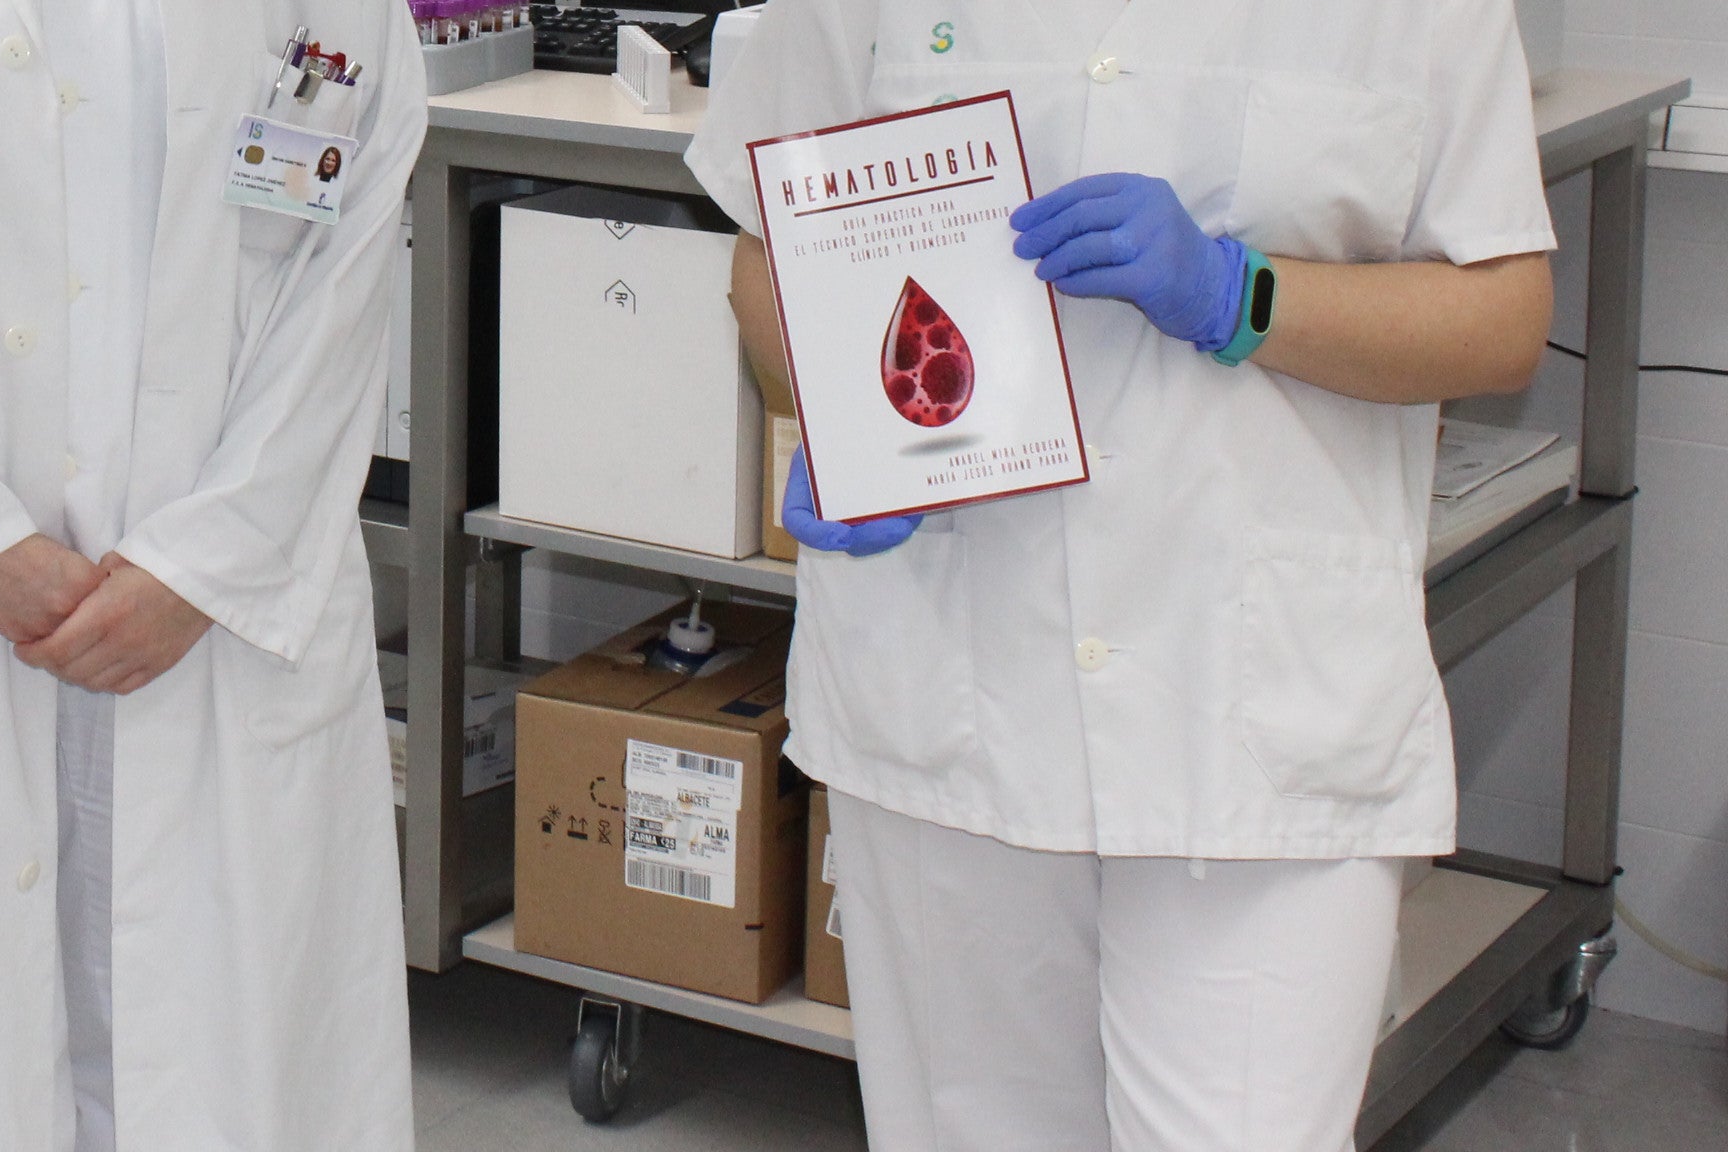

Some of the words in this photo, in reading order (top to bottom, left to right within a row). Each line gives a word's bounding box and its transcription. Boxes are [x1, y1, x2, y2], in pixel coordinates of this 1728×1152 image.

[782, 141, 998, 206] HEMATOLOGÍA
[931, 200, 954, 214] PARA
[794, 245, 806, 257] EL
[864, 224, 914, 244] SUPERIOR
[922, 220, 933, 233] DE
[941, 206, 1010, 229] LABORATORIO
[948, 452, 985, 468] ANABEL
[991, 447, 1016, 460] MIRA
[1022, 437, 1067, 455] REQUENA
[1001, 458, 1032, 473] RUANO
[1039, 452, 1070, 467] PARRA
[677, 792, 711, 808] ALBACETE
[629, 831, 658, 846] FARMA
[704, 824, 730, 842] ALMA
